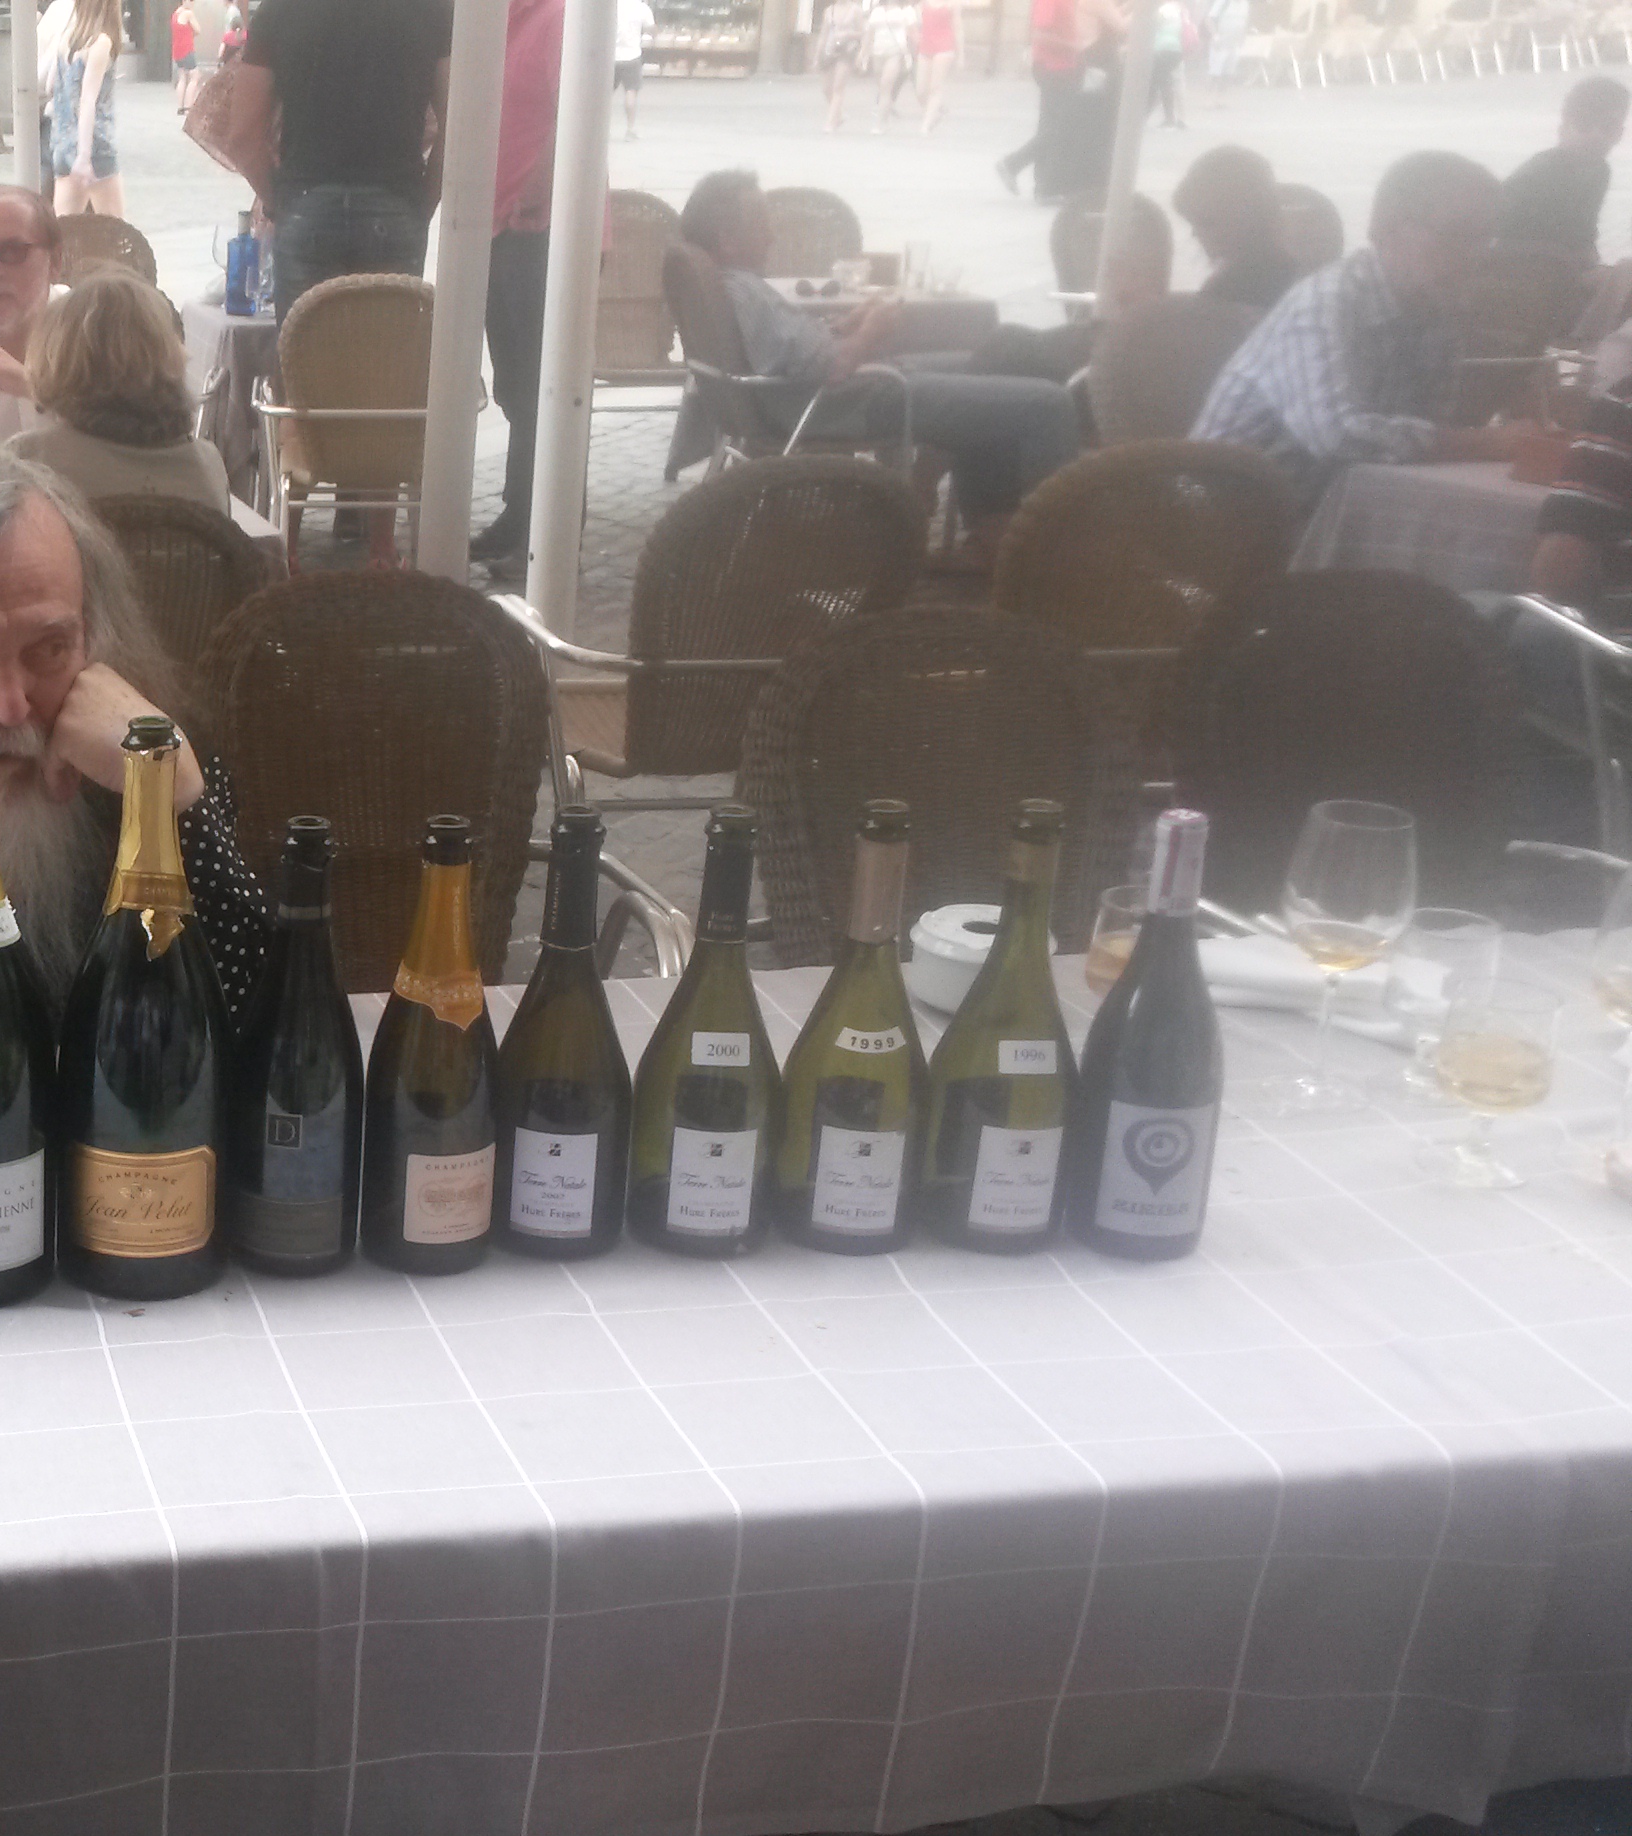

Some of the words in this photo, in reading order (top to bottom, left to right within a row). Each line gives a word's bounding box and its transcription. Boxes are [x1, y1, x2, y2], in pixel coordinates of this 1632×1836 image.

[706, 1043, 741, 1057] 2000
[850, 1036, 895, 1051] 1999
[275, 1119, 296, 1142] D
[97, 1171, 178, 1186] CHAMPAGNE
[85, 1195, 129, 1219] Jean
